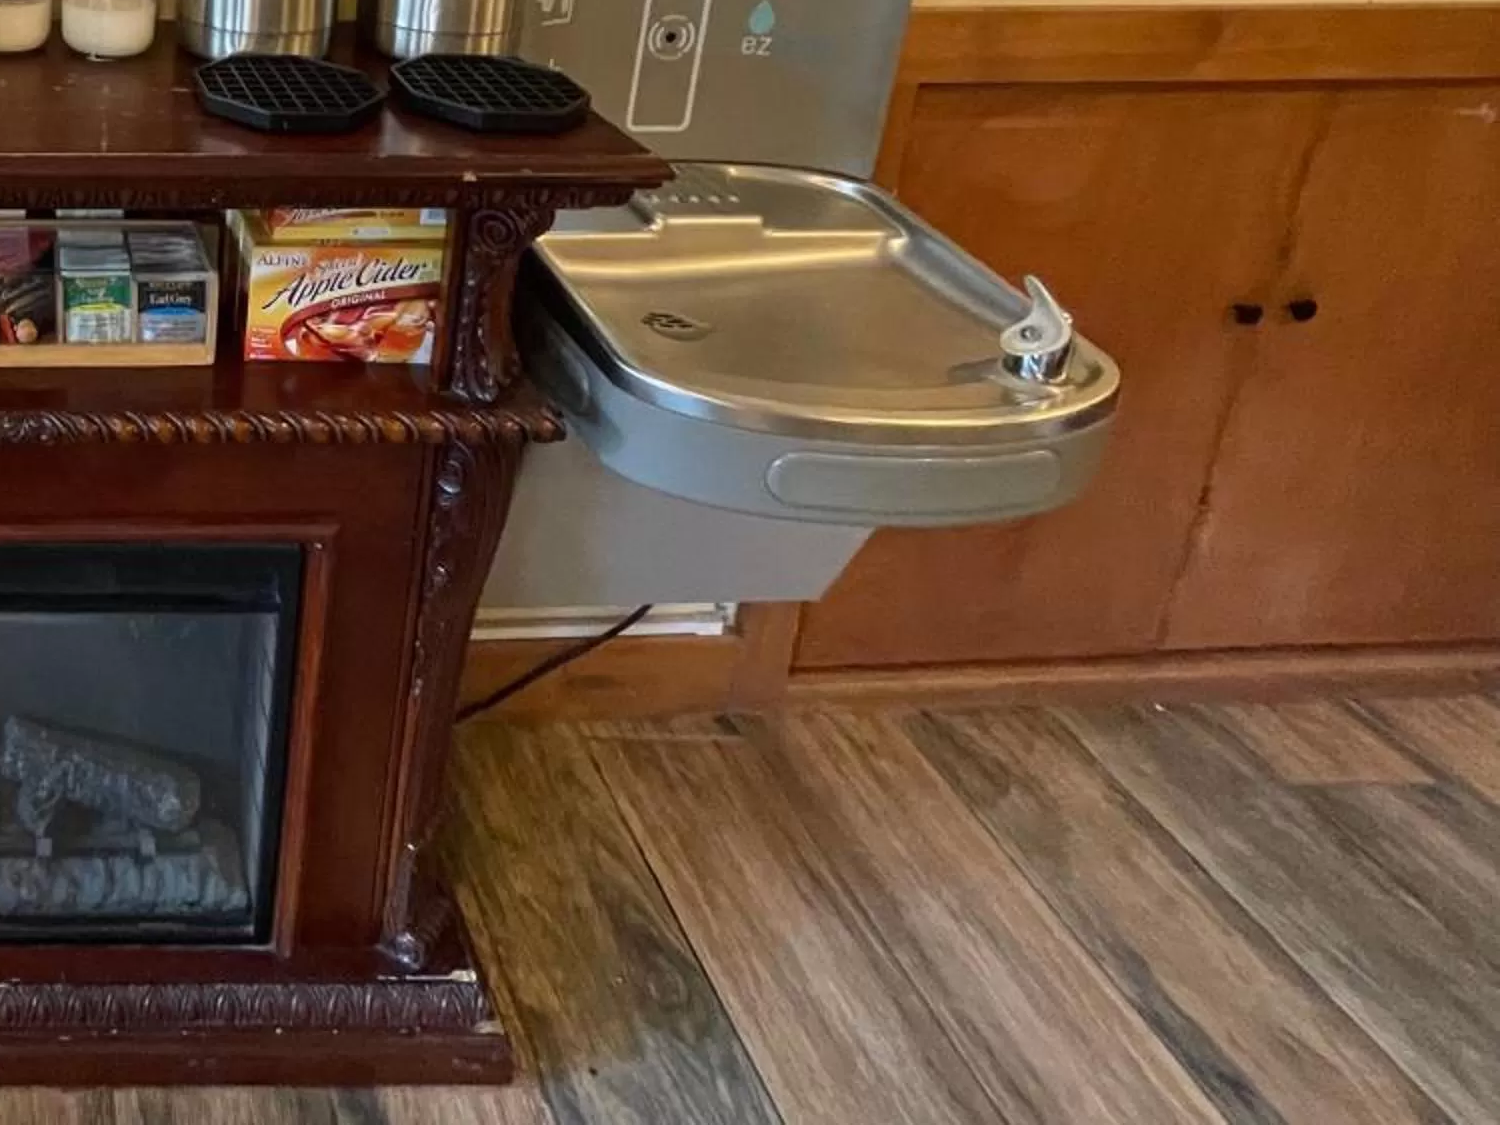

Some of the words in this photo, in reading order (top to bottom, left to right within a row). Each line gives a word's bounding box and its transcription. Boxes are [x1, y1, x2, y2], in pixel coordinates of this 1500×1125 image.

[740, 35, 773, 56] ez
[261, 271, 355, 310] Apple
[355, 257, 421, 287] Cider
[331, 290, 388, 308] ORIGINAL
